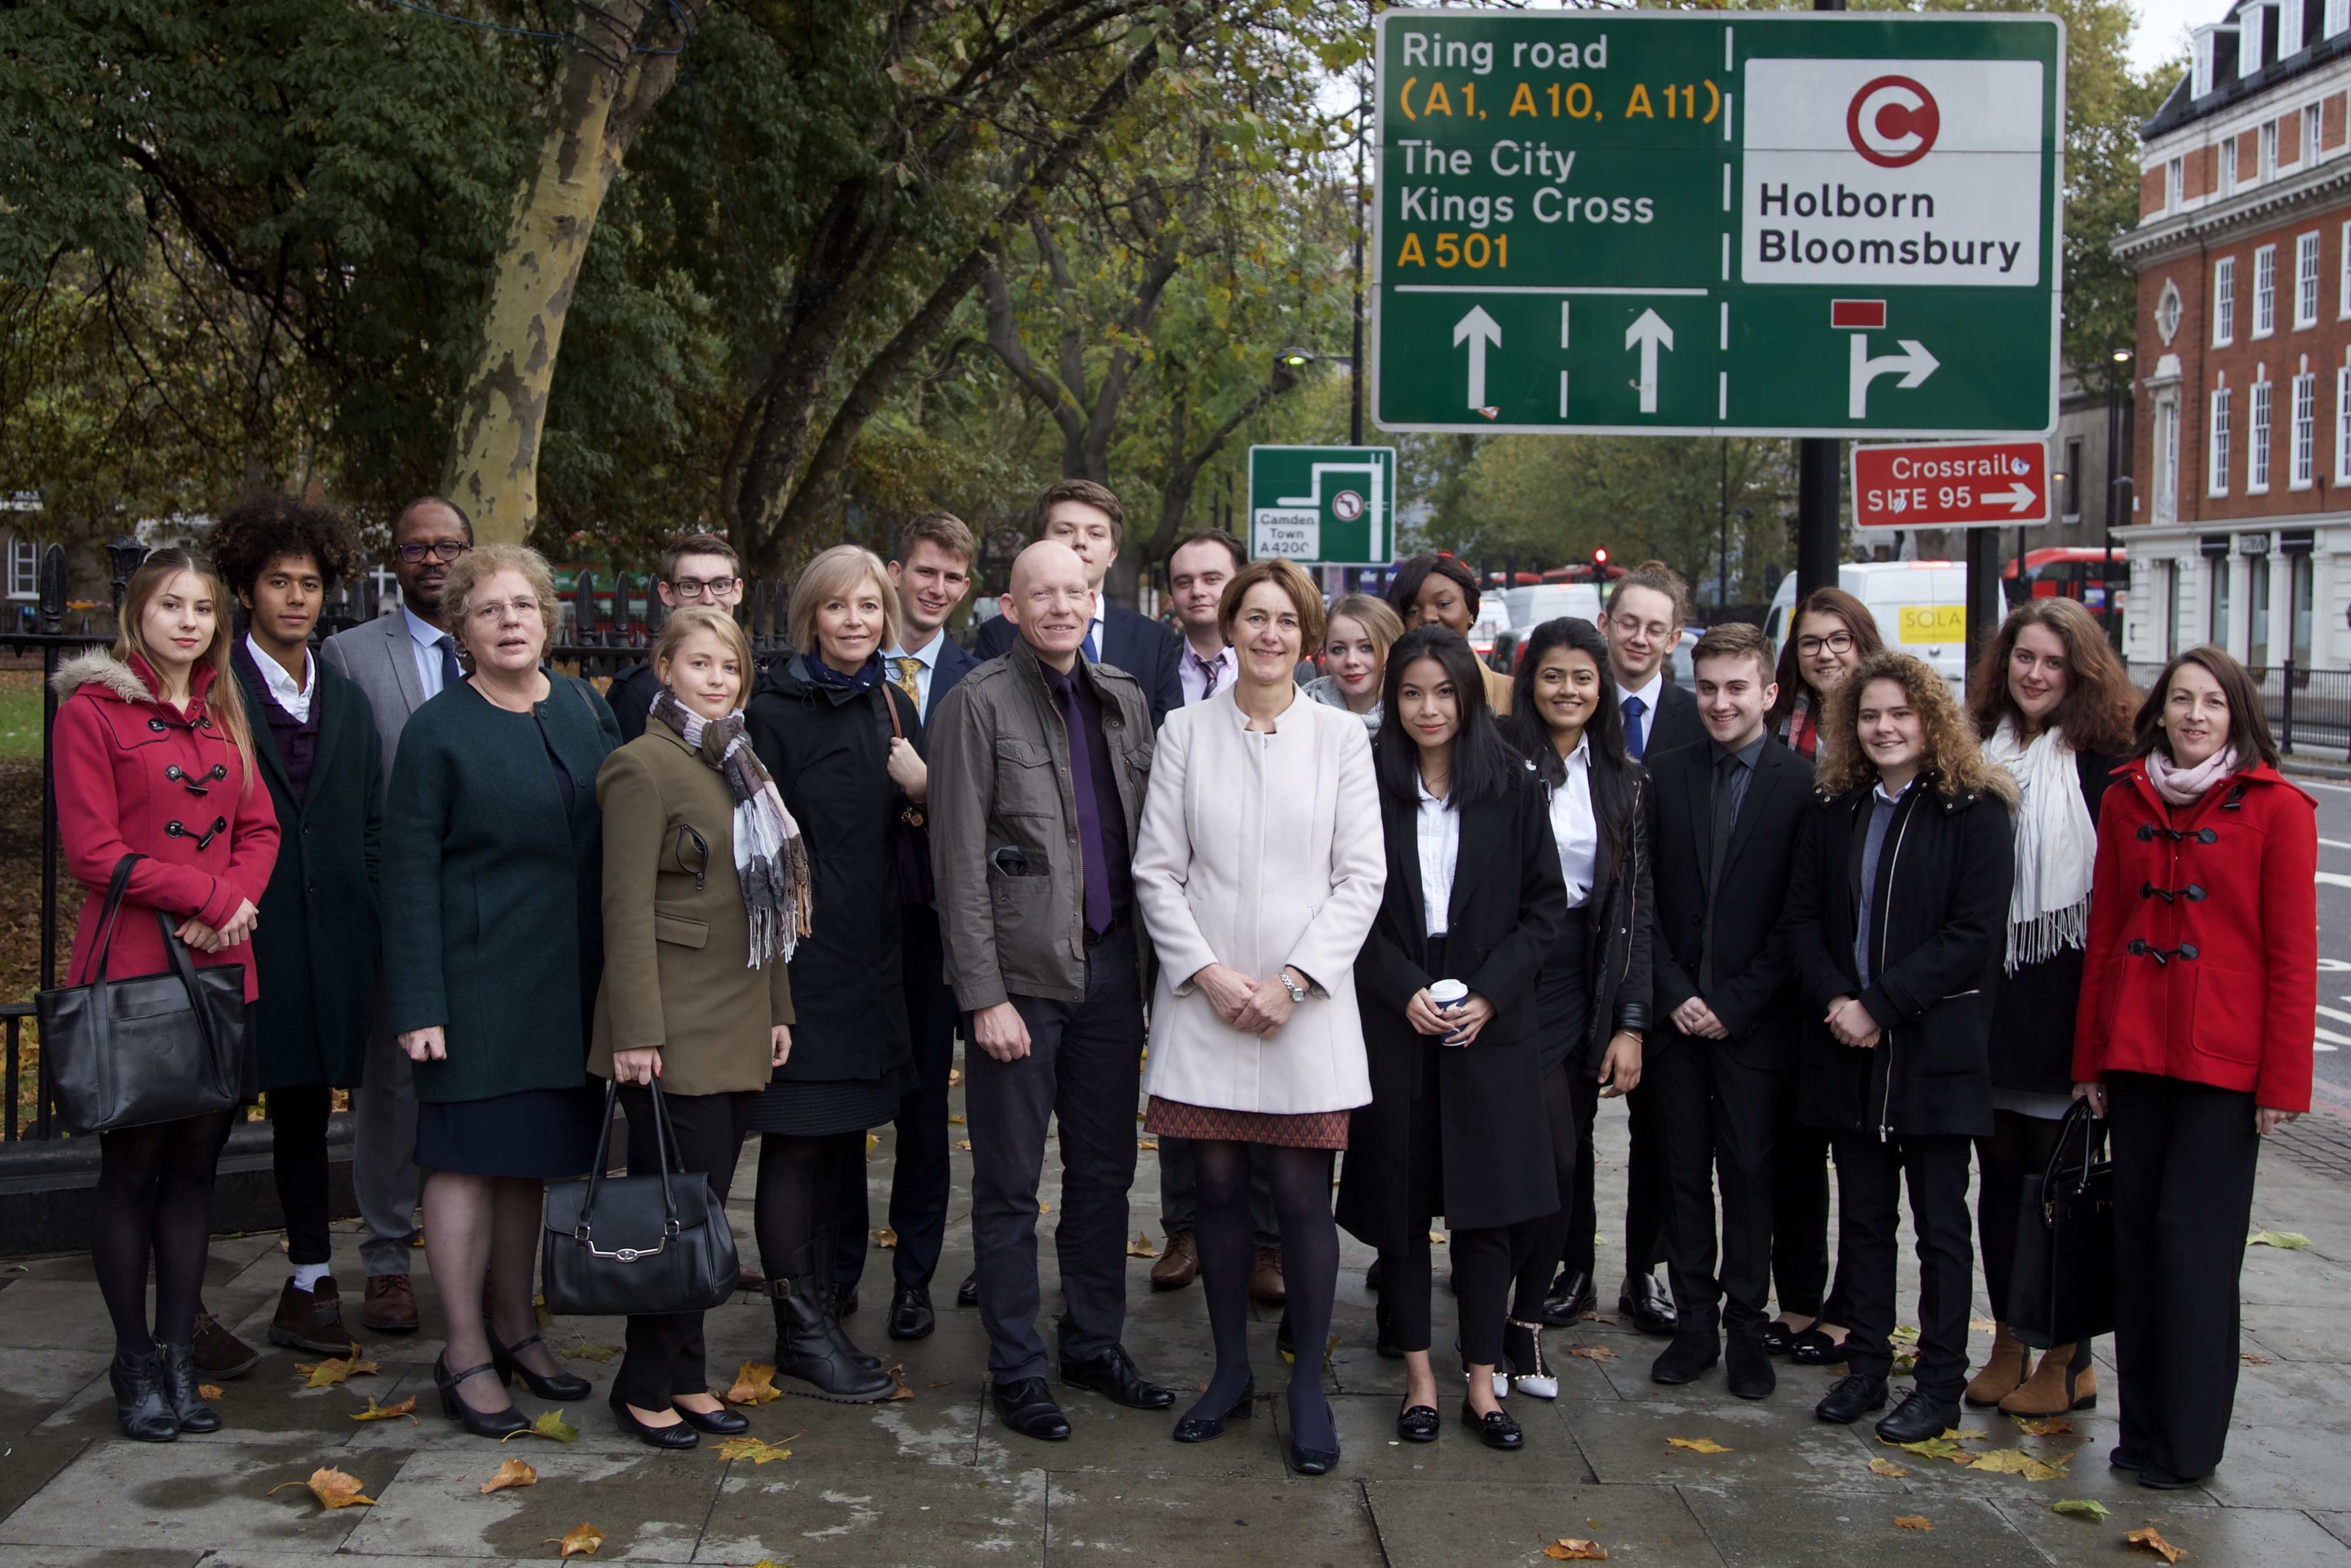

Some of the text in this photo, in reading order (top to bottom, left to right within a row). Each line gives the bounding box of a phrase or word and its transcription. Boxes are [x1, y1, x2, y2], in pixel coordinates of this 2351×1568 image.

[1403, 32, 1607, 75] Ring road
[1509, 82, 1603, 121] A10,
[1625, 79, 1720, 124] A11)
[1398, 139, 1576, 183] The City
[1401, 186, 1654, 228] Kings Cross
[1760, 183, 1934, 218] Holborn
[1760, 229, 2021, 273] Bloomsbury
[1892, 453, 2009, 480] Crossrail
[1867, 486, 1972, 512] SITE 95
[1261, 514, 1314, 524] Camden
[1270, 528, 1304, 538] Town
[1905, 610, 1962, 629] SOLA
